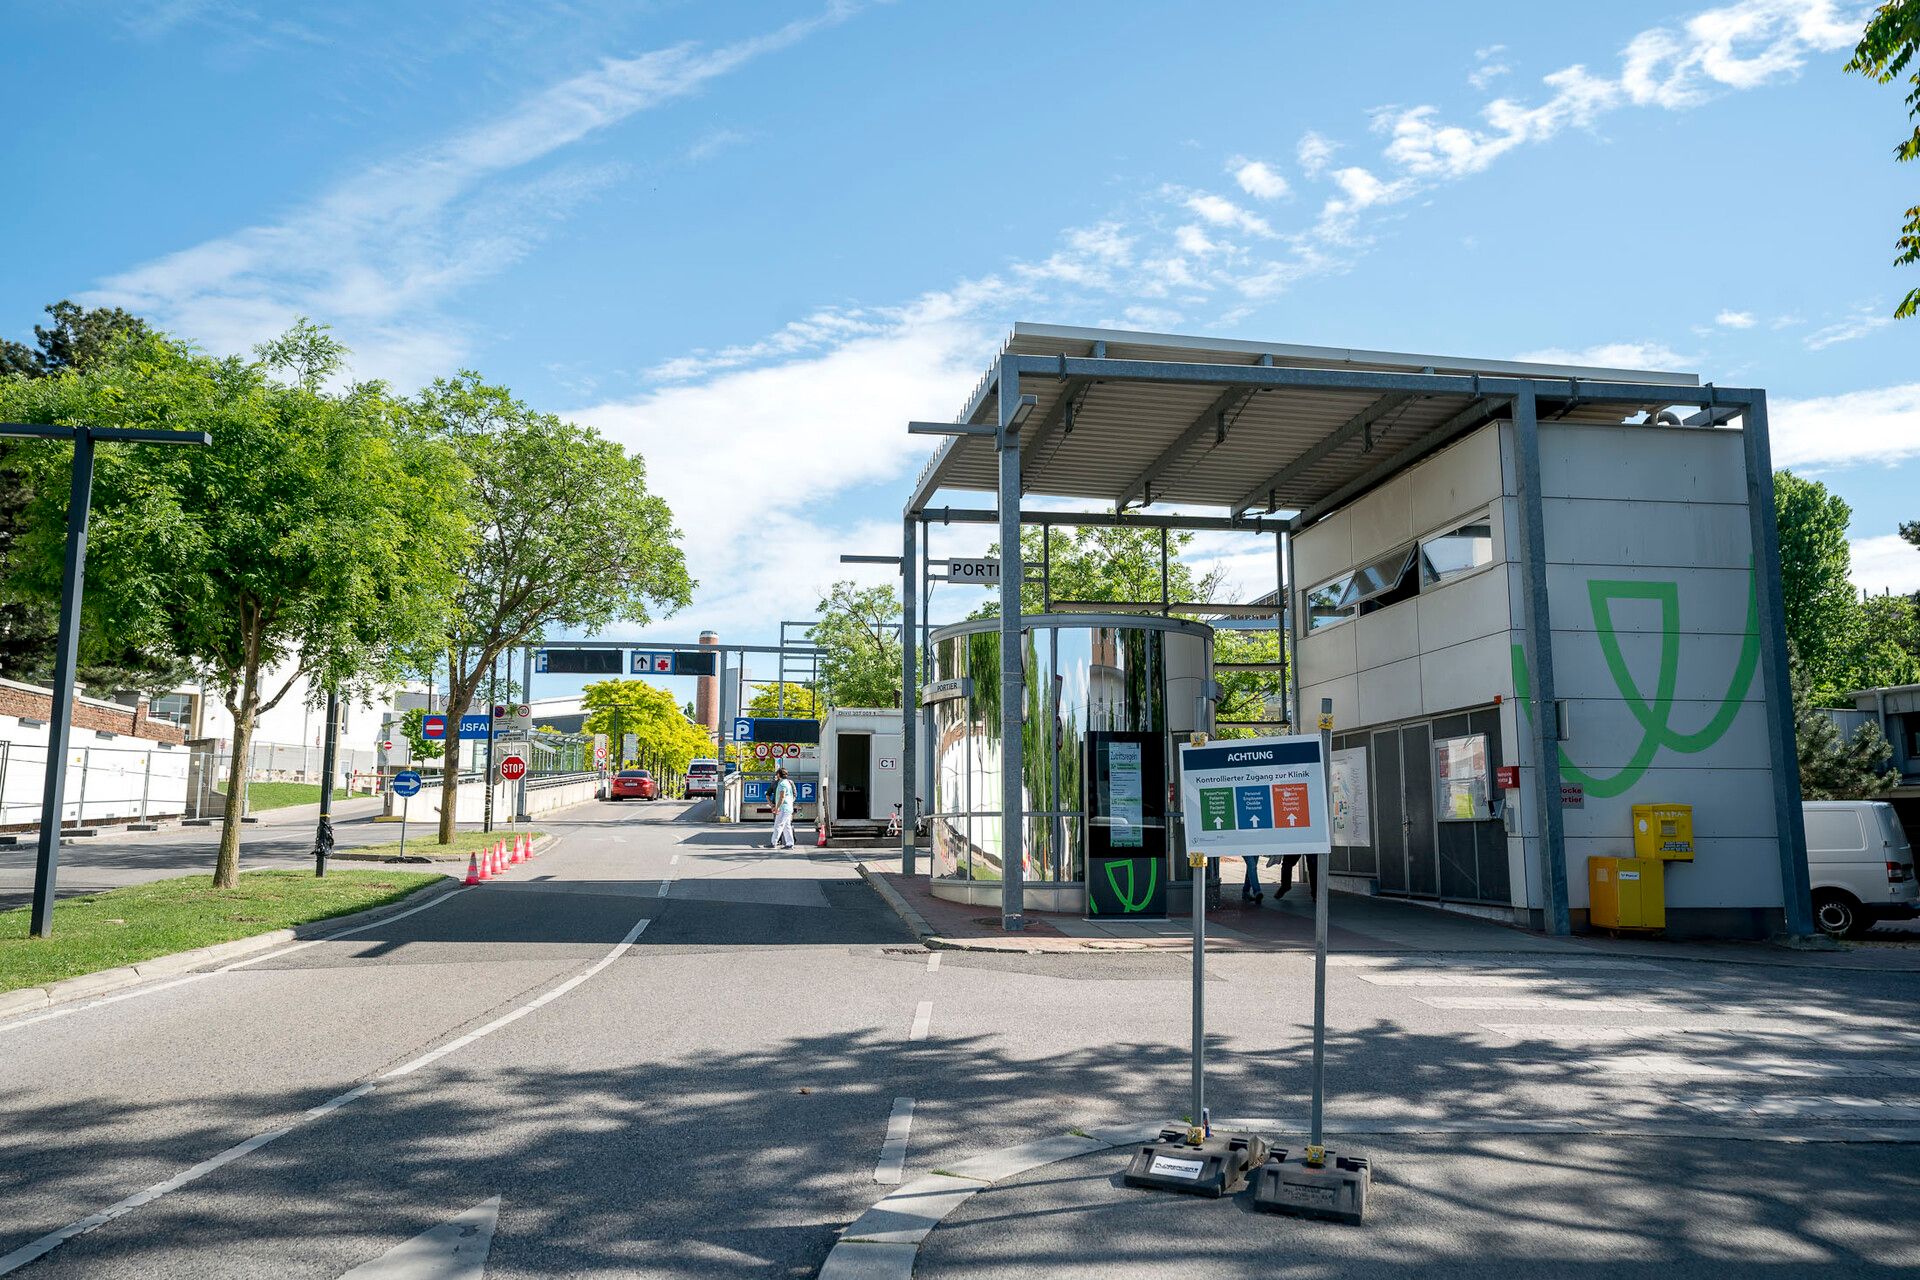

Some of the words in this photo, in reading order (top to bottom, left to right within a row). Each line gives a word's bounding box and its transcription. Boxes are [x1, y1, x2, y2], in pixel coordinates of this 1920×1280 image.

[953, 563, 1000, 576] PORTI
[937, 682, 958, 692] PORTIER
[459, 722, 489, 732] USFA
[1227, 750, 1274, 761] ACHTUNG
[503, 763, 524, 773] STOP
[1196, 775, 1244, 784] Kontrollierter
[1246, 773, 1273, 782] Zugang
[1288, 770, 1310, 778] Klinik
